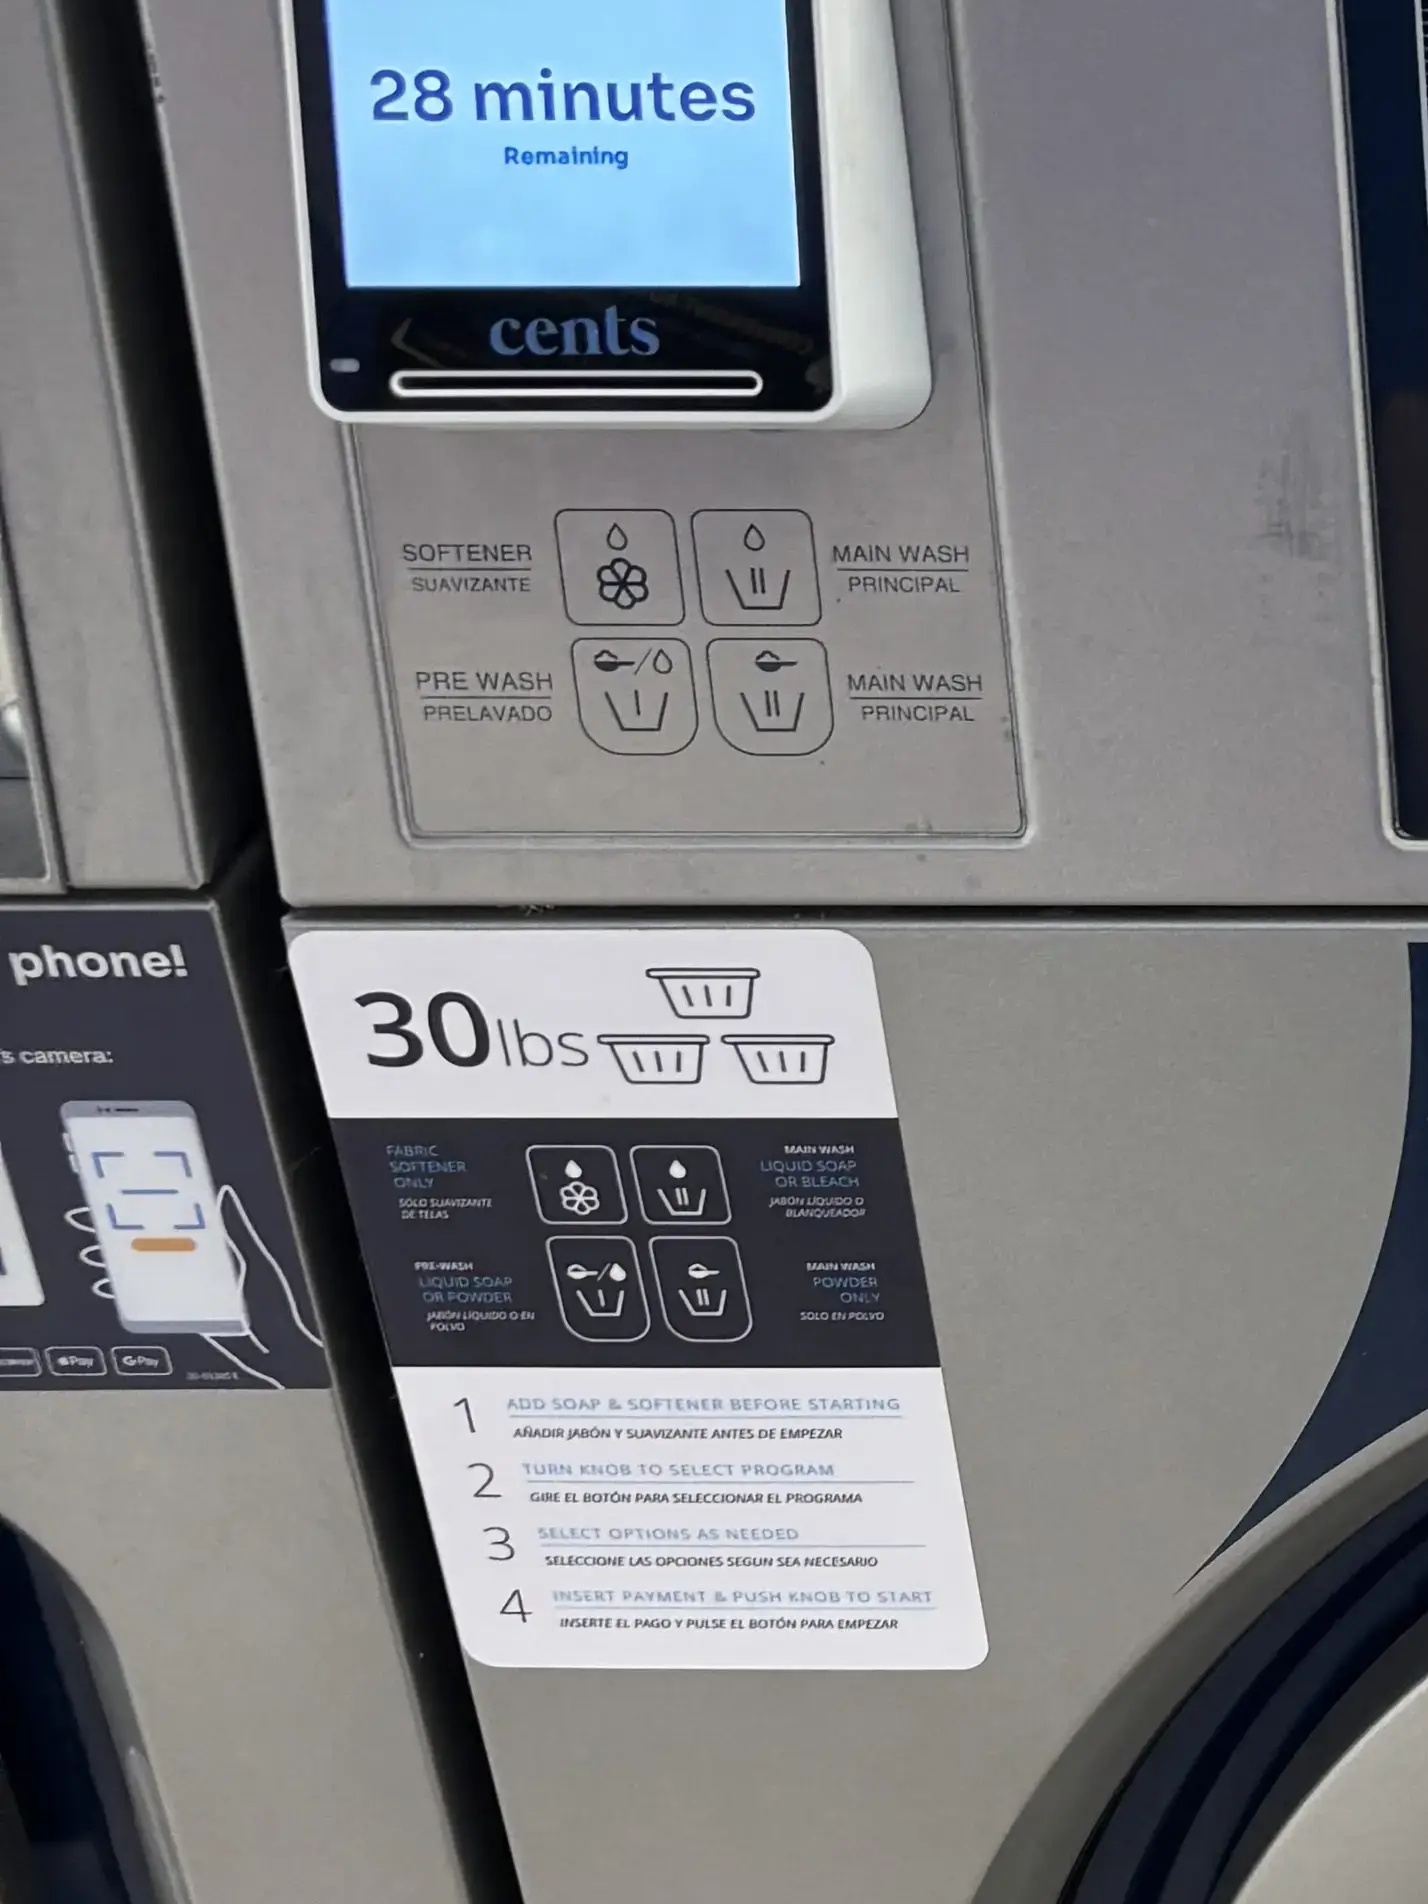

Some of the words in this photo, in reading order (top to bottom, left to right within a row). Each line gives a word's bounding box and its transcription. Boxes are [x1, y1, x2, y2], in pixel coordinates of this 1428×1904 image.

[369, 68, 453, 122] 28
[476, 68, 757, 122] minutes
[504, 146, 629, 170] Remaining
[489, 304, 660, 356] cents
[402, 544, 532, 562] SOFTENER
[832, 545, 892, 563] MAIN
[898, 545, 970, 563] WASH
[412, 576, 531, 593] SUAVIZANTE
[848, 576, 960, 594] PRINCIPAL
[415, 672, 470, 691] PRE
[477, 672, 553, 691] WASH
[848, 674, 905, 692] MAIN
[911, 674, 983, 692] WASH
[424, 705, 552, 722] PRELAVADO
[861, 705, 975, 722] PRINCIPAL
[8, 944, 189, 985] phone!
[19, 1049, 113, 1065] camera:
[386, 1145, 439, 1157] FABRIC
[784, 1145, 816, 1155] MAIN
[818, 1145, 855, 1155] WASH
[389, 1161, 467, 1173] SOFTENER
[760, 1160, 813, 1173] LIQUID
[816, 1160, 857, 1172] SOAP
[394, 1177, 434, 1189] ONLY
[775, 1176, 798, 1188] OR
[801, 1176, 860, 1188] BLEACH
[806, 1262, 838, 1271] MAIN
[840, 1262, 876, 1271] WASH
[419, 1277, 469, 1289] LIQUID
[473, 1277, 513, 1287] SOAP
[813, 1277, 878, 1288] POWDER
[422, 1292, 445, 1303] OR
[447, 1292, 512, 1303] POWDER
[840, 1292, 880, 1303] ONLY
[848, 1311, 885, 1321] POLVO
[454, 1397, 476, 1433] 1
[507, 1398, 546, 1411] ADD
[553, 1398, 600, 1411] SOAP
[609, 1398, 622, 1411] &
[627, 1398, 723, 1411] SOFTENER
[731, 1398, 801, 1411] BEFORE
[808, 1398, 900, 1411] STARTING
[513, 1425, 565, 1439] AÑADIR
[566, 1426, 611, 1440] JABÓN
[614, 1428, 623, 1439] Y
[626, 1428, 708, 1439] SUAVIZANTE
[710, 1428, 755, 1439] ANTES
[758, 1428, 776, 1439] DE
[780, 1428, 843, 1439] EMPEZAR
[467, 1462, 502, 1498] 2
[521, 1463, 573, 1476] TURN
[580, 1463, 632, 1476] KNOB
[637, 1463, 663, 1476] TO
[668, 1463, 735, 1476] SELECT
[741, 1464, 835, 1477] PROGRAM
[530, 1492, 561, 1503] GIRE
[565, 1492, 579, 1503] EL
[583, 1491, 631, 1503] BOTÓN
[635, 1492, 669, 1503] PARA
[673, 1492, 763, 1504] SELECCIONAR
[767, 1493, 782, 1504] EL
[785, 1493, 863, 1504] PROGRAMA
[482, 1526, 515, 1561] 3
[537, 1527, 601, 1540] SELECT
[608, 1527, 691, 1540] OPTIONS
[697, 1528, 720, 1540] AS
[726, 1528, 800, 1541] NEEDED
[545, 1555, 625, 1567] SELECCIONE
[628, 1555, 652, 1567] LAS
[655, 1555, 724, 1567] OPCIONES
[777, 1556, 801, 1567] SEA
[804, 1556, 878, 1567] NECESARIO
[499, 1588, 533, 1623] 4
[552, 1590, 615, 1603] INSERT
[622, 1590, 705, 1603] PAYMENT
[732, 1591, 782, 1603] PUSH
[788, 1591, 841, 1603] KNOB
[849, 1591, 871, 1603] TO
[877, 1591, 933, 1603] START
[560, 1618, 612, 1629] INSERTE
[616, 1618, 630, 1629] EL
[634, 1618, 672, 1629] PAGO
[674, 1618, 683, 1629] Y
[686, 1618, 726, 1629] PULSE
[730, 1619, 745, 1629] EL
[749, 1617, 797, 1629] BOTÓN
[800, 1619, 834, 1629] PARA
[838, 1619, 899, 1630] EMPEZAR
